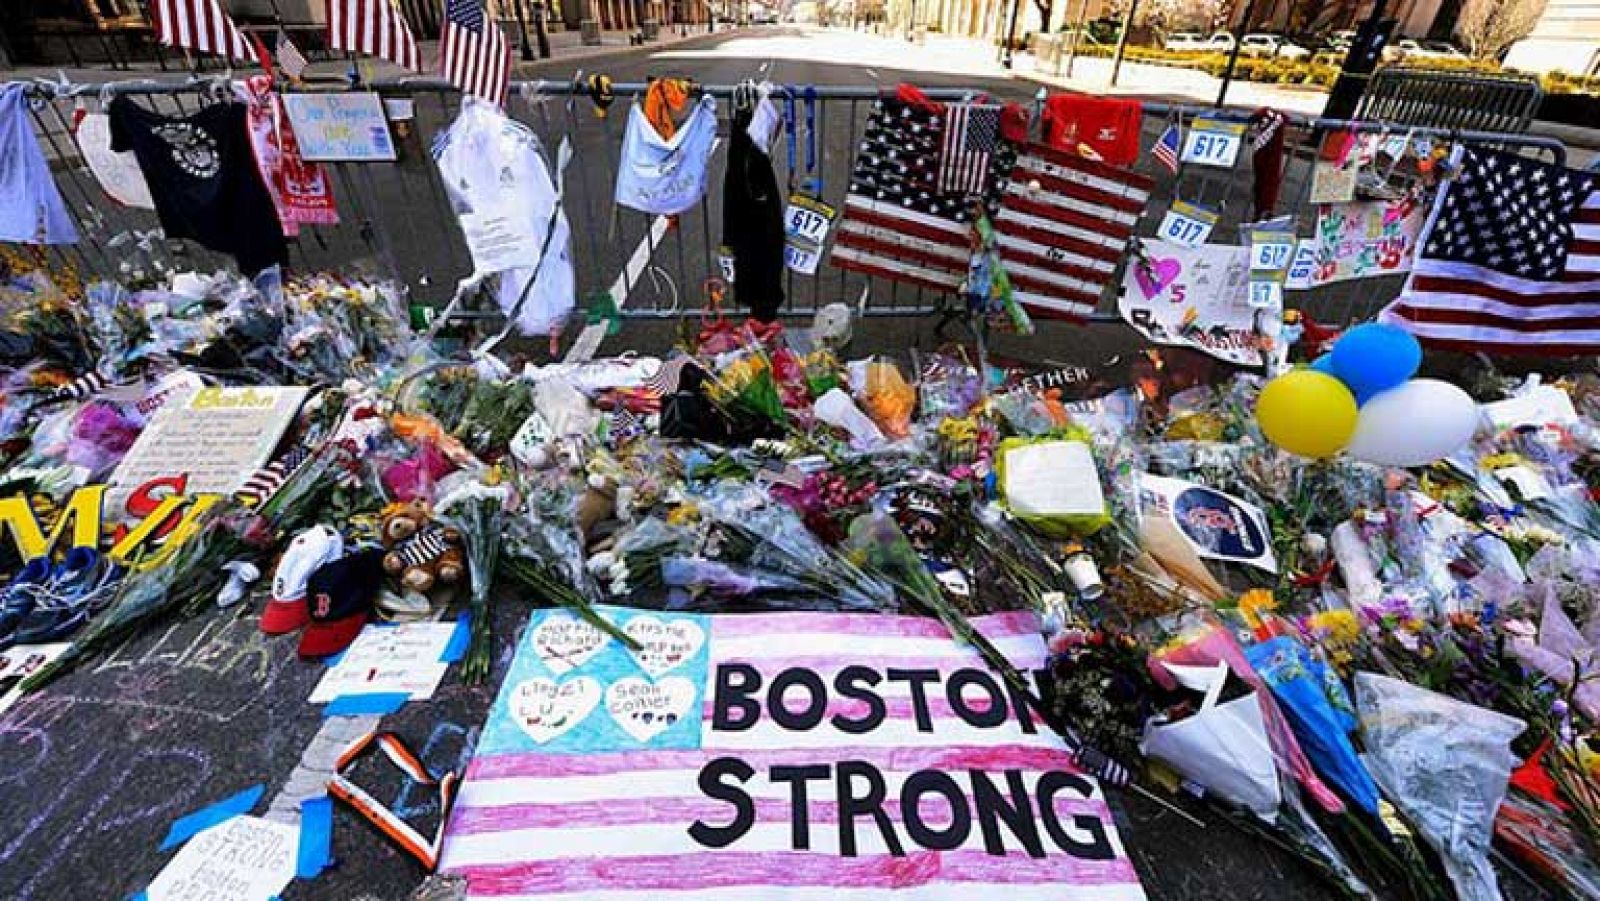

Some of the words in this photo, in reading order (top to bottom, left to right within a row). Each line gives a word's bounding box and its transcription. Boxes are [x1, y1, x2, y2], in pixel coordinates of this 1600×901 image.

[1193, 134, 1229, 158] 617
[792, 210, 823, 234] 617
[1168, 220, 1203, 242] 617
[712, 662, 1056, 736] BOSTON
[688, 756, 1117, 861] STRONG
